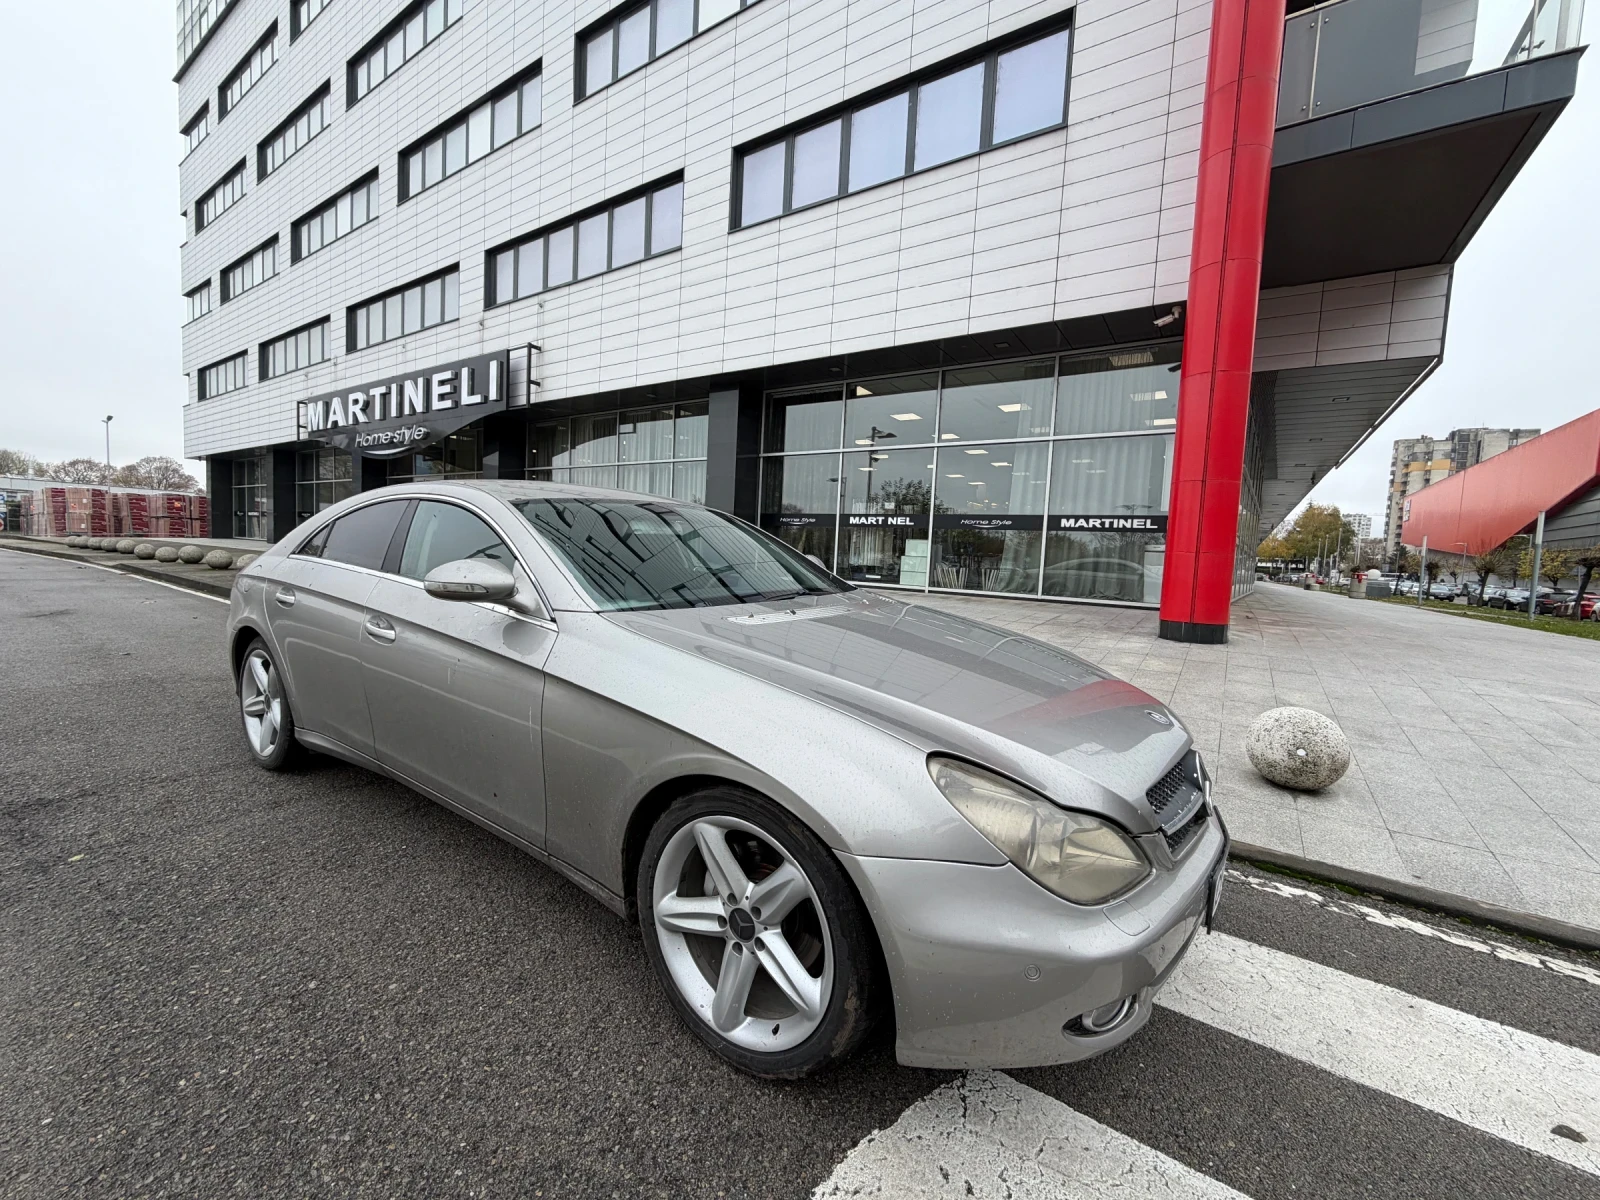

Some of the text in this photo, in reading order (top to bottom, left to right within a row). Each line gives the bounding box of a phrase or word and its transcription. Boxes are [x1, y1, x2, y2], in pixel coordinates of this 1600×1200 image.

[307, 359, 500, 432] MARTINELI
[355, 432, 391, 447] Home
[1060, 518, 1158, 529] MARTINEL
